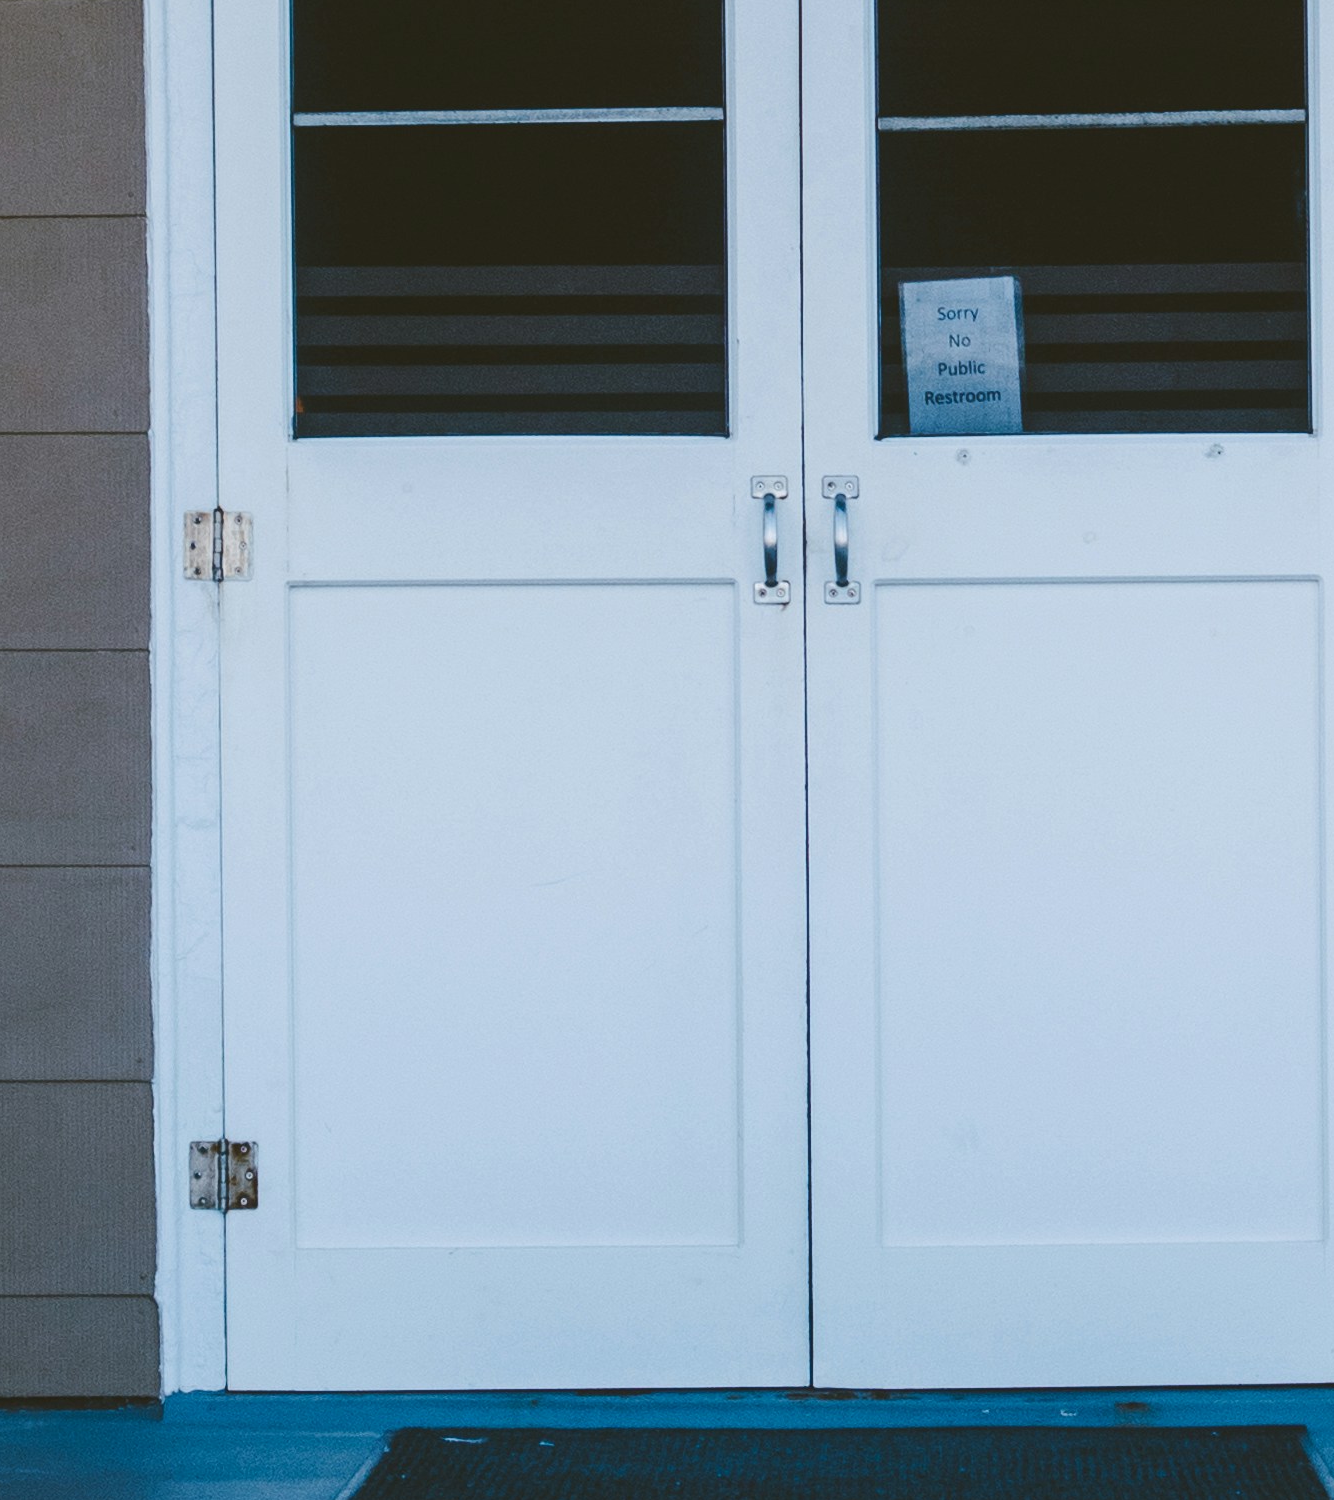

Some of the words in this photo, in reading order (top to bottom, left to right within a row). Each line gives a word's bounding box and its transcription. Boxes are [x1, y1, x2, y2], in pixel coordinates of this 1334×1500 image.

[937, 307, 979, 322] Sorry
[949, 334, 971, 347] No
[938, 361, 986, 376] Public
[925, 390, 1001, 405] Restroom
